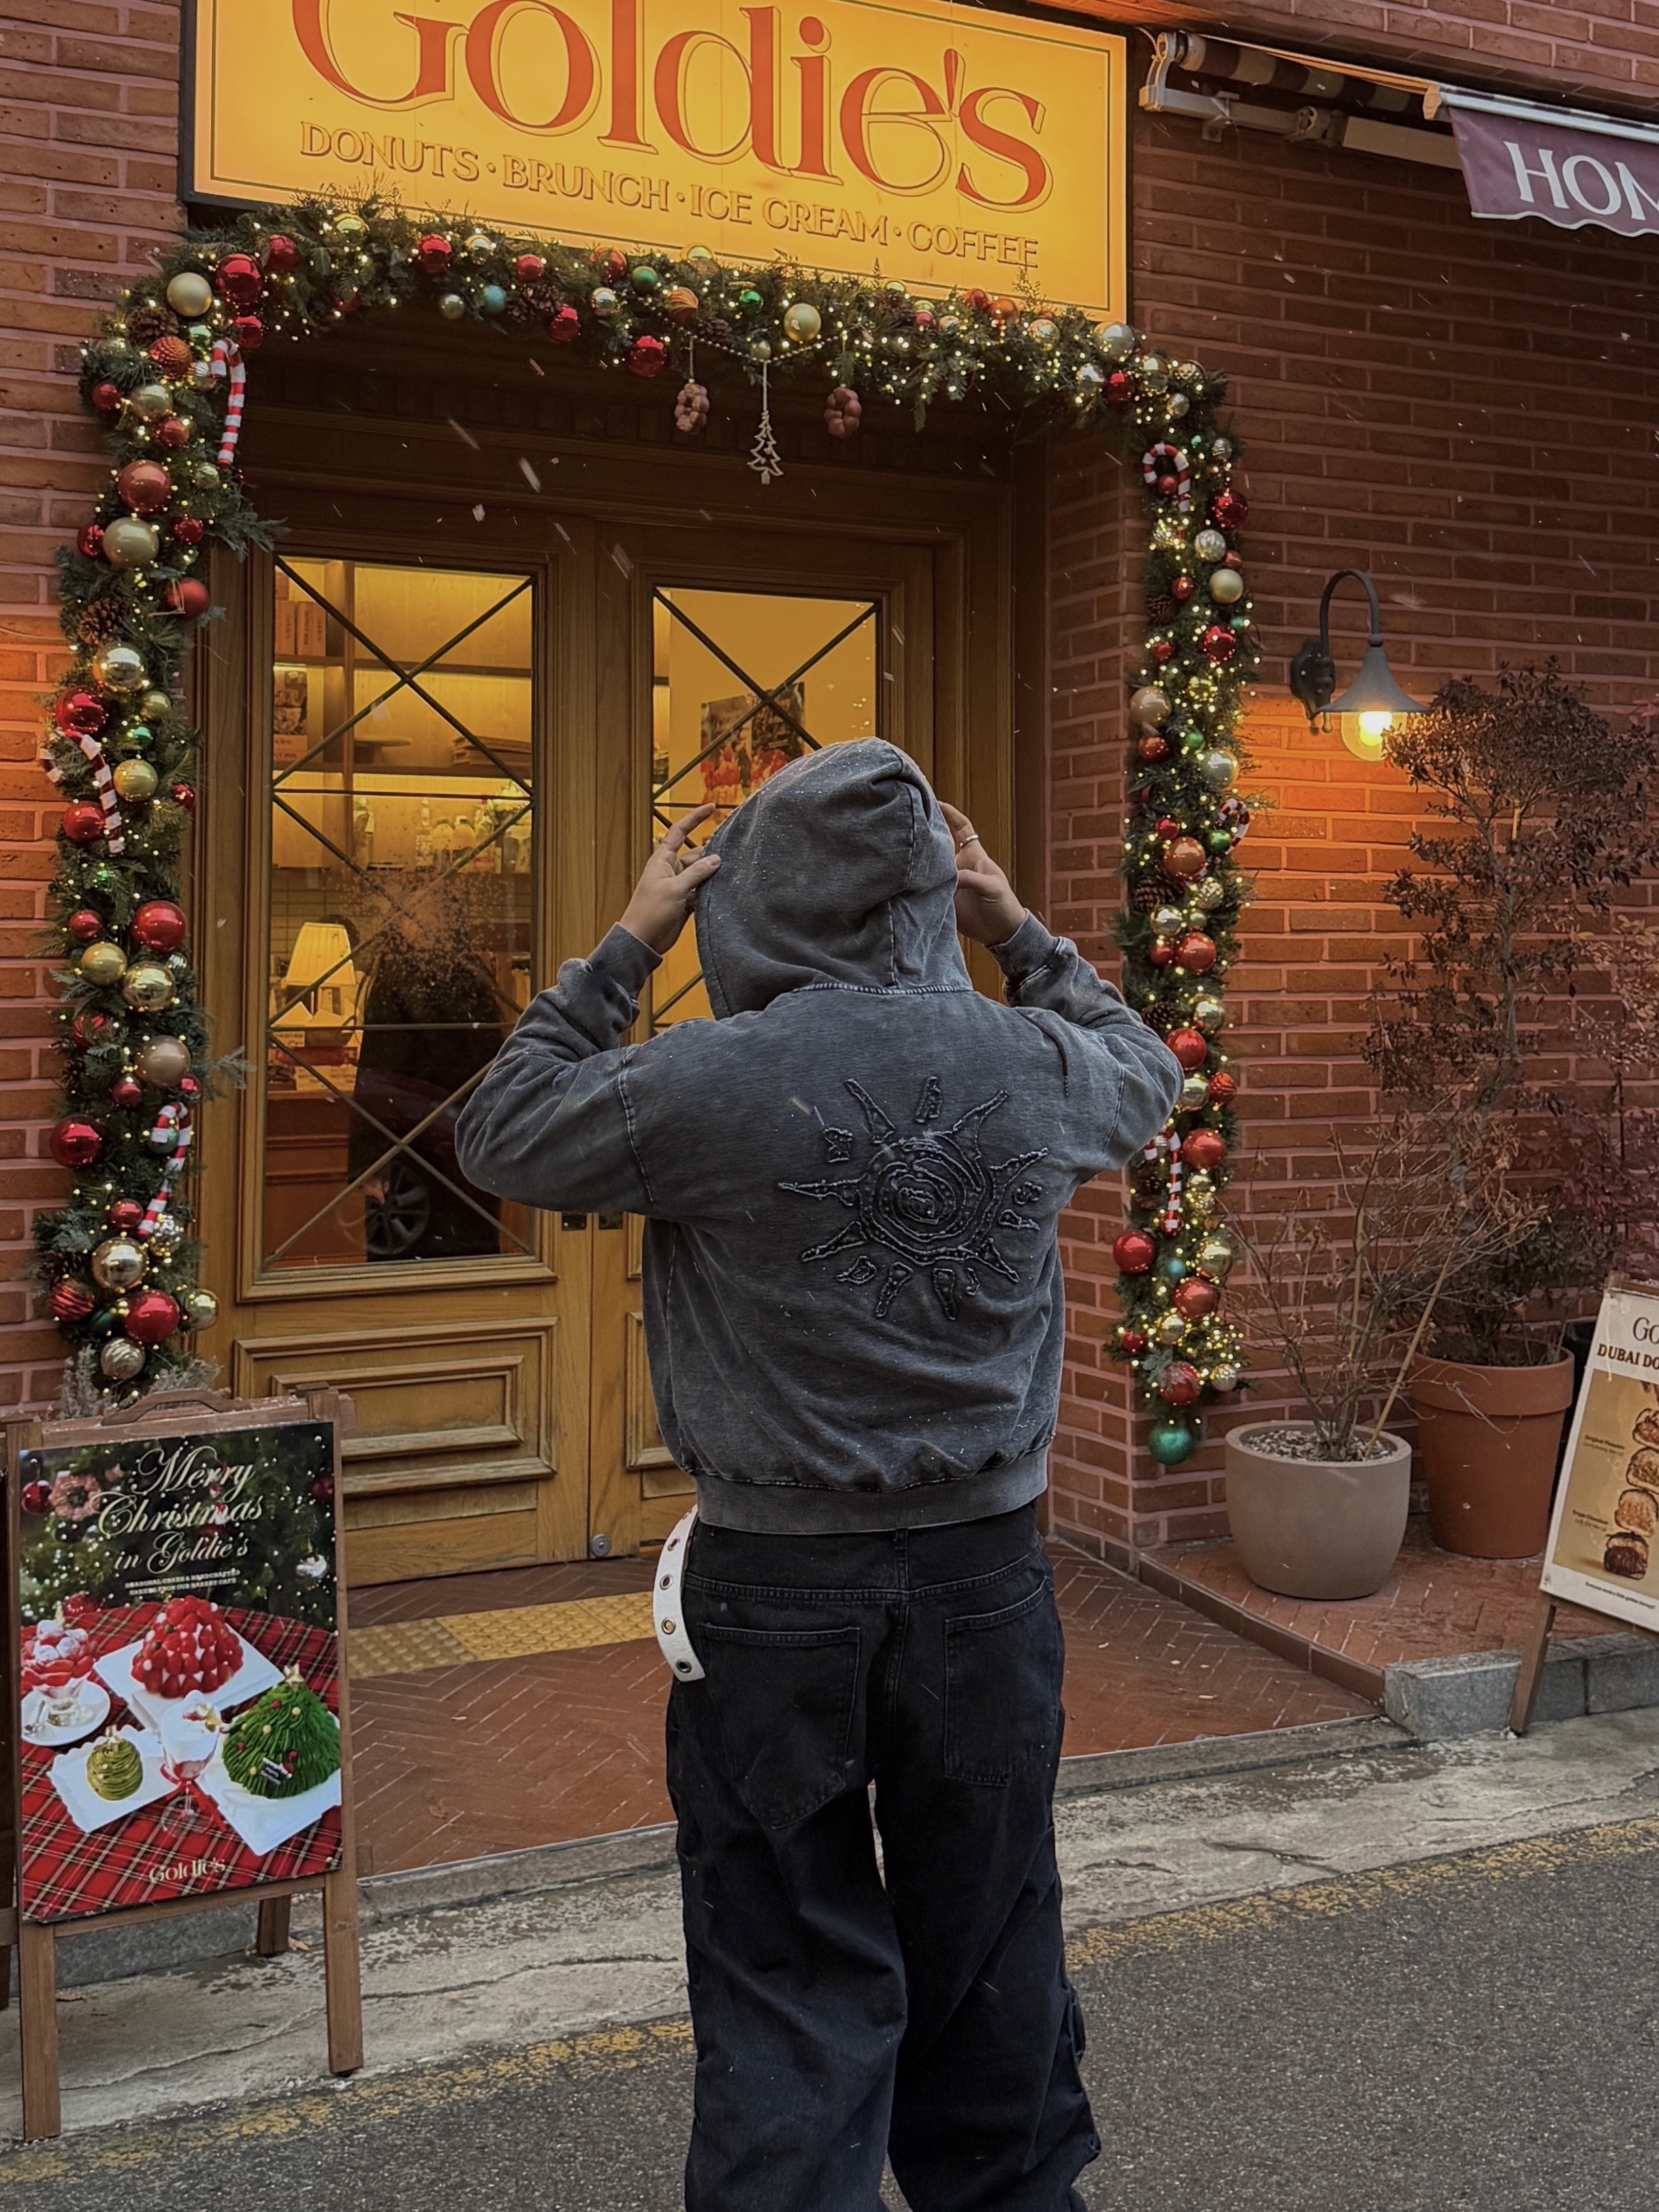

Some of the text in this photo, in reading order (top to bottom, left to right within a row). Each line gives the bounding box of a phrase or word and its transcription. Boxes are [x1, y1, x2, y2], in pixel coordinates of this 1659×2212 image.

[292, 0, 1053, 213] Goldie's
[300, 121, 1039, 269] DONUTS BRUNCH ICE CREAM COFFEE
[1596, 1343, 1641, 1366] DUBAI
[131, 1445, 257, 1503] Merry
[88, 1491, 264, 1537] Christmas
[114, 1531, 249, 1574] in Goldie's
[149, 1857, 226, 1883] Goldie's
